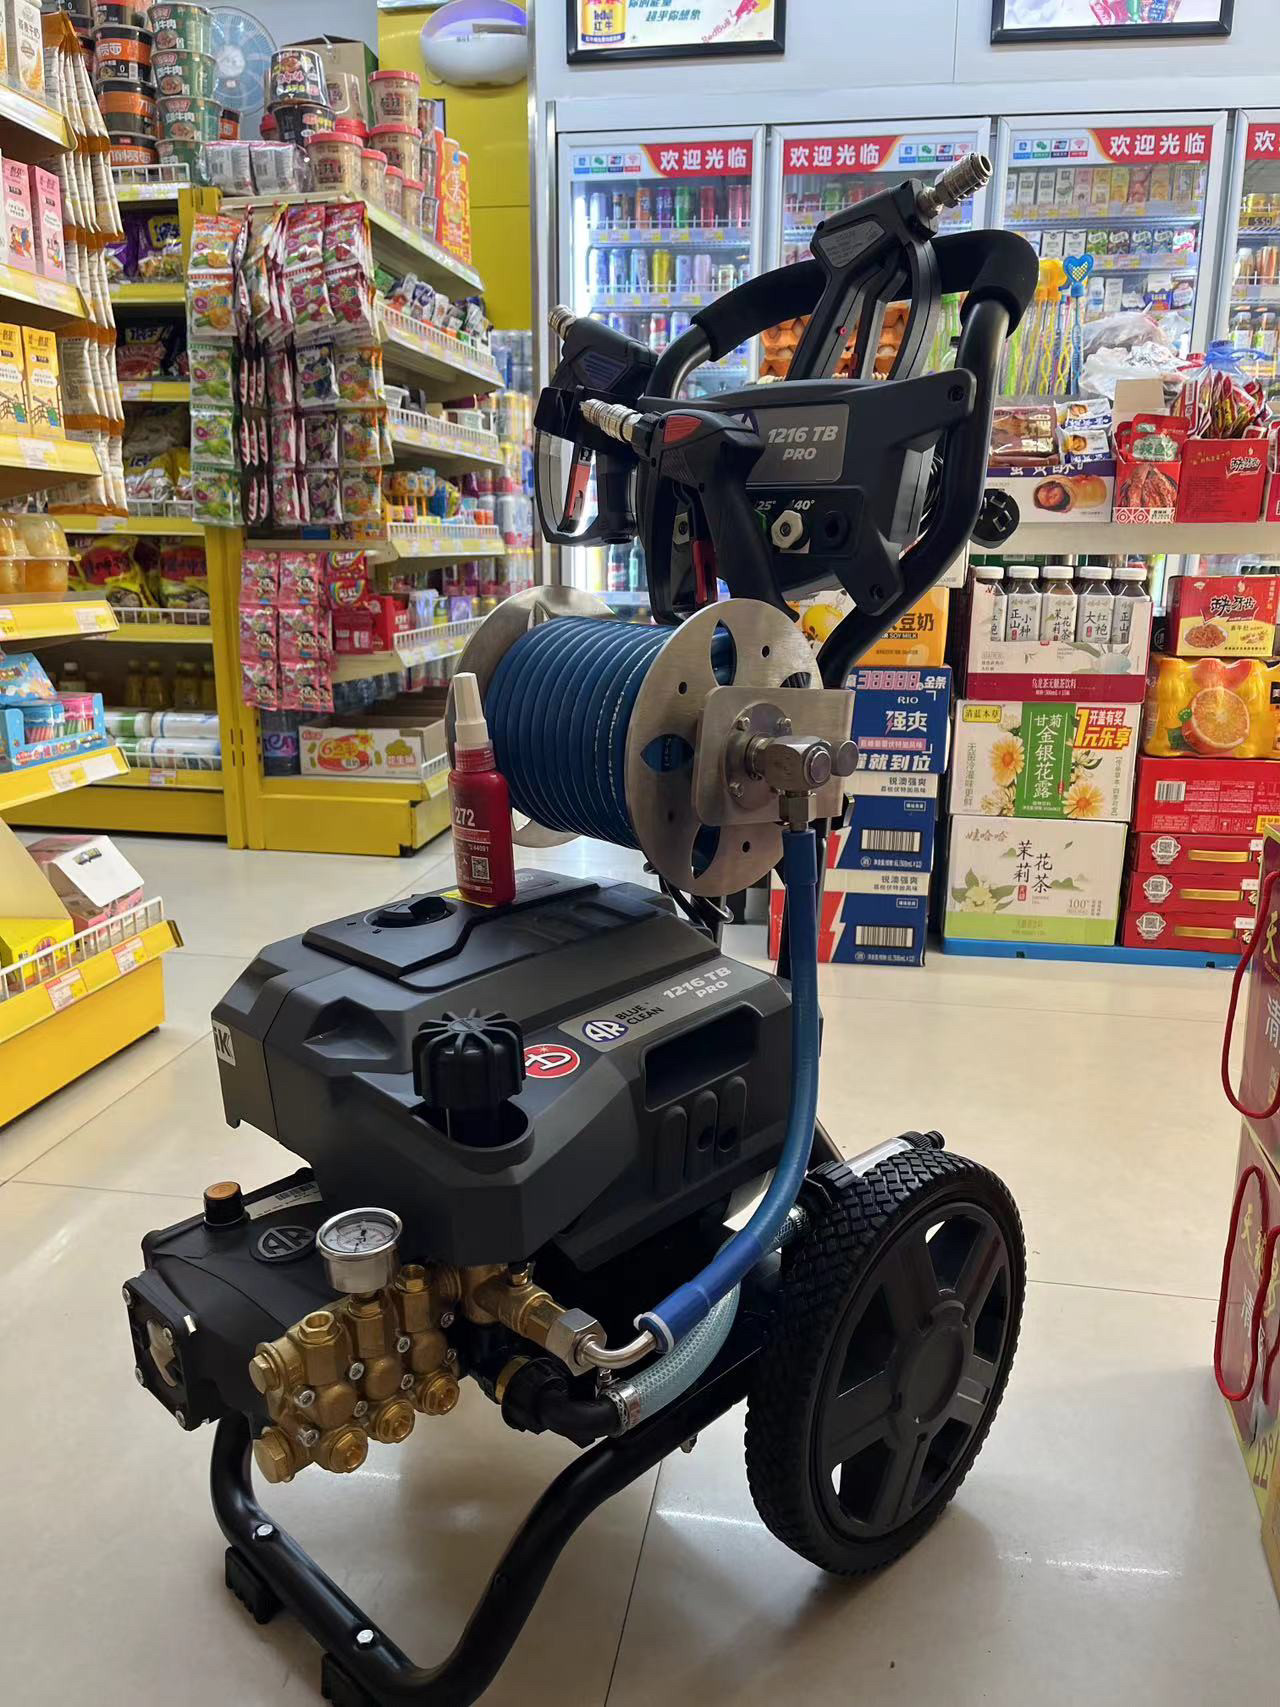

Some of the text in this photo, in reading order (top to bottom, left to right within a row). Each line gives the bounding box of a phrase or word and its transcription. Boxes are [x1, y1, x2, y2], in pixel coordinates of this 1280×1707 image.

[1108, 132, 1206, 156] 欢迎光临
[659, 147, 747, 171] 欢迎光临
[789, 143, 881, 168] 欢迎光临
[768, 425, 839, 443] 1216 TB
[782, 447, 817, 460] PRO
[892, 613, 935, 631] 豆奶
[897, 696, 919, 704] RIO
[885, 711, 928, 733] 强爽
[1034, 714, 1063, 728] 甘菊
[1089, 709, 1124, 726] 开盖有奖
[1032, 726, 1058, 799] 金银花露
[454, 806, 476, 827] 272
[965, 828, 1009, 843] 娃哈哈
[1013, 839, 1034, 883] 茉莉
[1031, 853, 1053, 894] 花茶
[663, 966, 733, 999] 1216 TB
[695, 980, 729, 999] PRO
[614, 1003, 646, 1021] BLUE
[626, 1006, 665, 1026] CLEAN
[583, 1020, 627, 1042] AR
